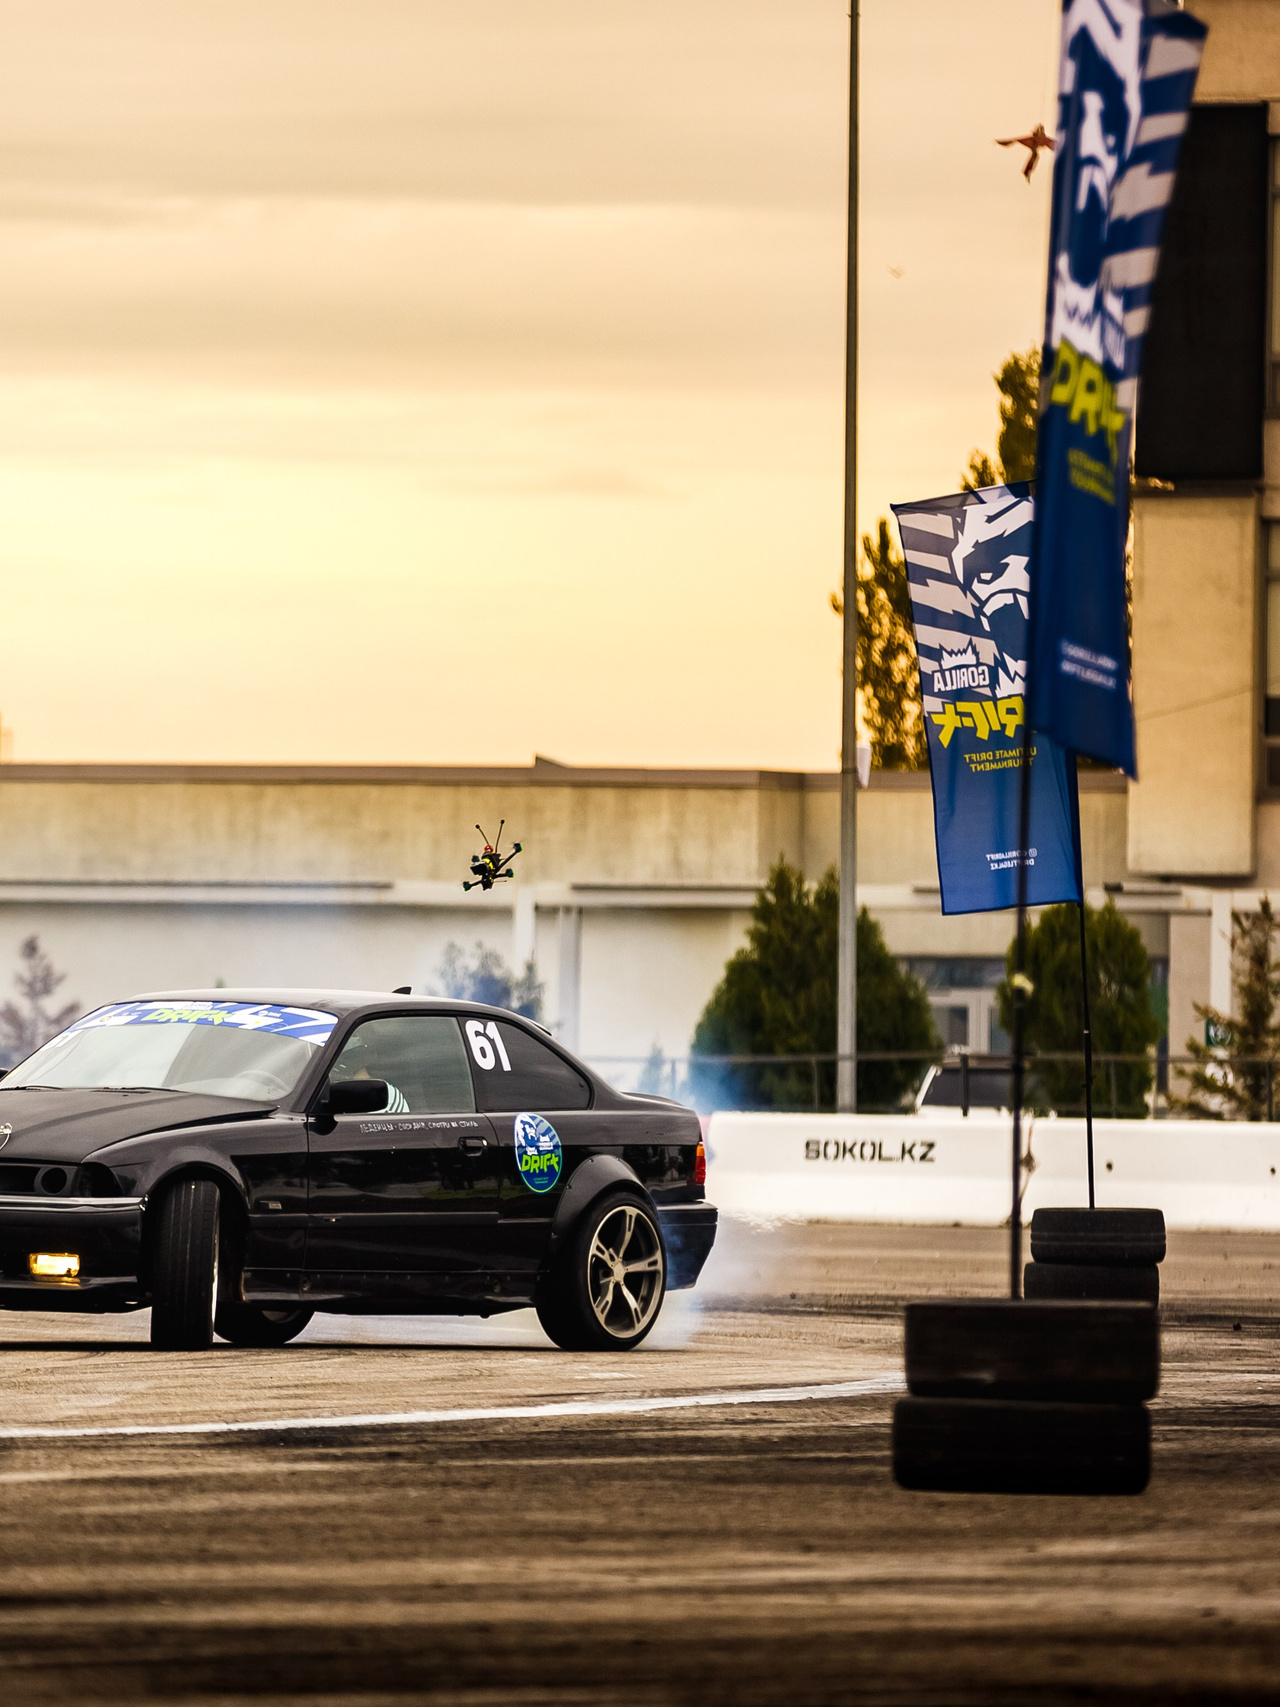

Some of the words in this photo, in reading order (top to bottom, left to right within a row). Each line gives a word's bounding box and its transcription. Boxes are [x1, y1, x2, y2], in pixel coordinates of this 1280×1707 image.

[140, 1008, 233, 1025] DRIFT
[465, 1020, 512, 1071] 61
[521, 1153, 559, 1174] DRIFT
